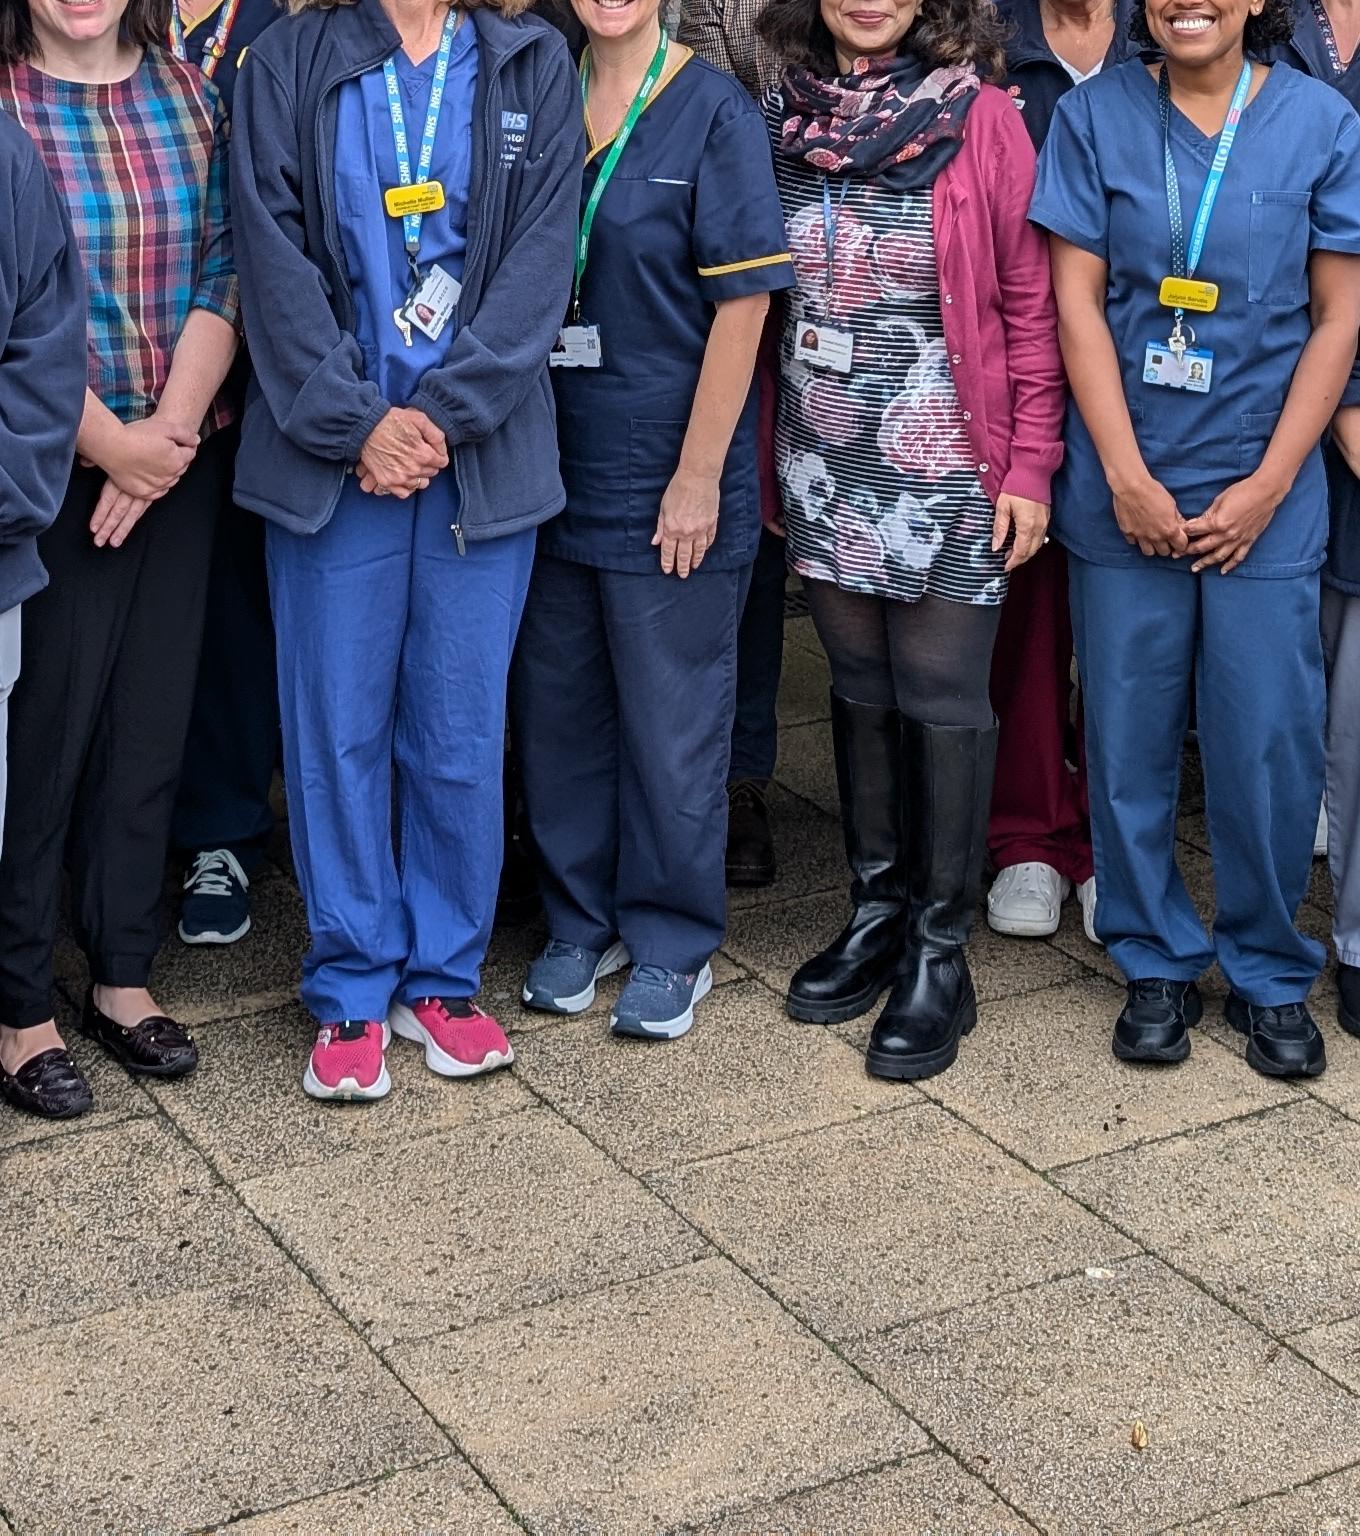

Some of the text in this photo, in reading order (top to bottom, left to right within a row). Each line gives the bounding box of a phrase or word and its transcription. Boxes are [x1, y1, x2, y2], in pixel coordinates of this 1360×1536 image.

[446, 10, 457, 30] NHS
[440, 34, 451, 54] NHS
[435, 59, 447, 81] NHS
[387, 74, 399, 95] NHS
[430, 87, 441, 109] NHS
[391, 102, 403, 124] NHS
[425, 114, 437, 138] NHS
[396, 131, 407, 154] NHS
[420, 144, 431, 168] NHS
[399, 160, 411, 185] NHS
